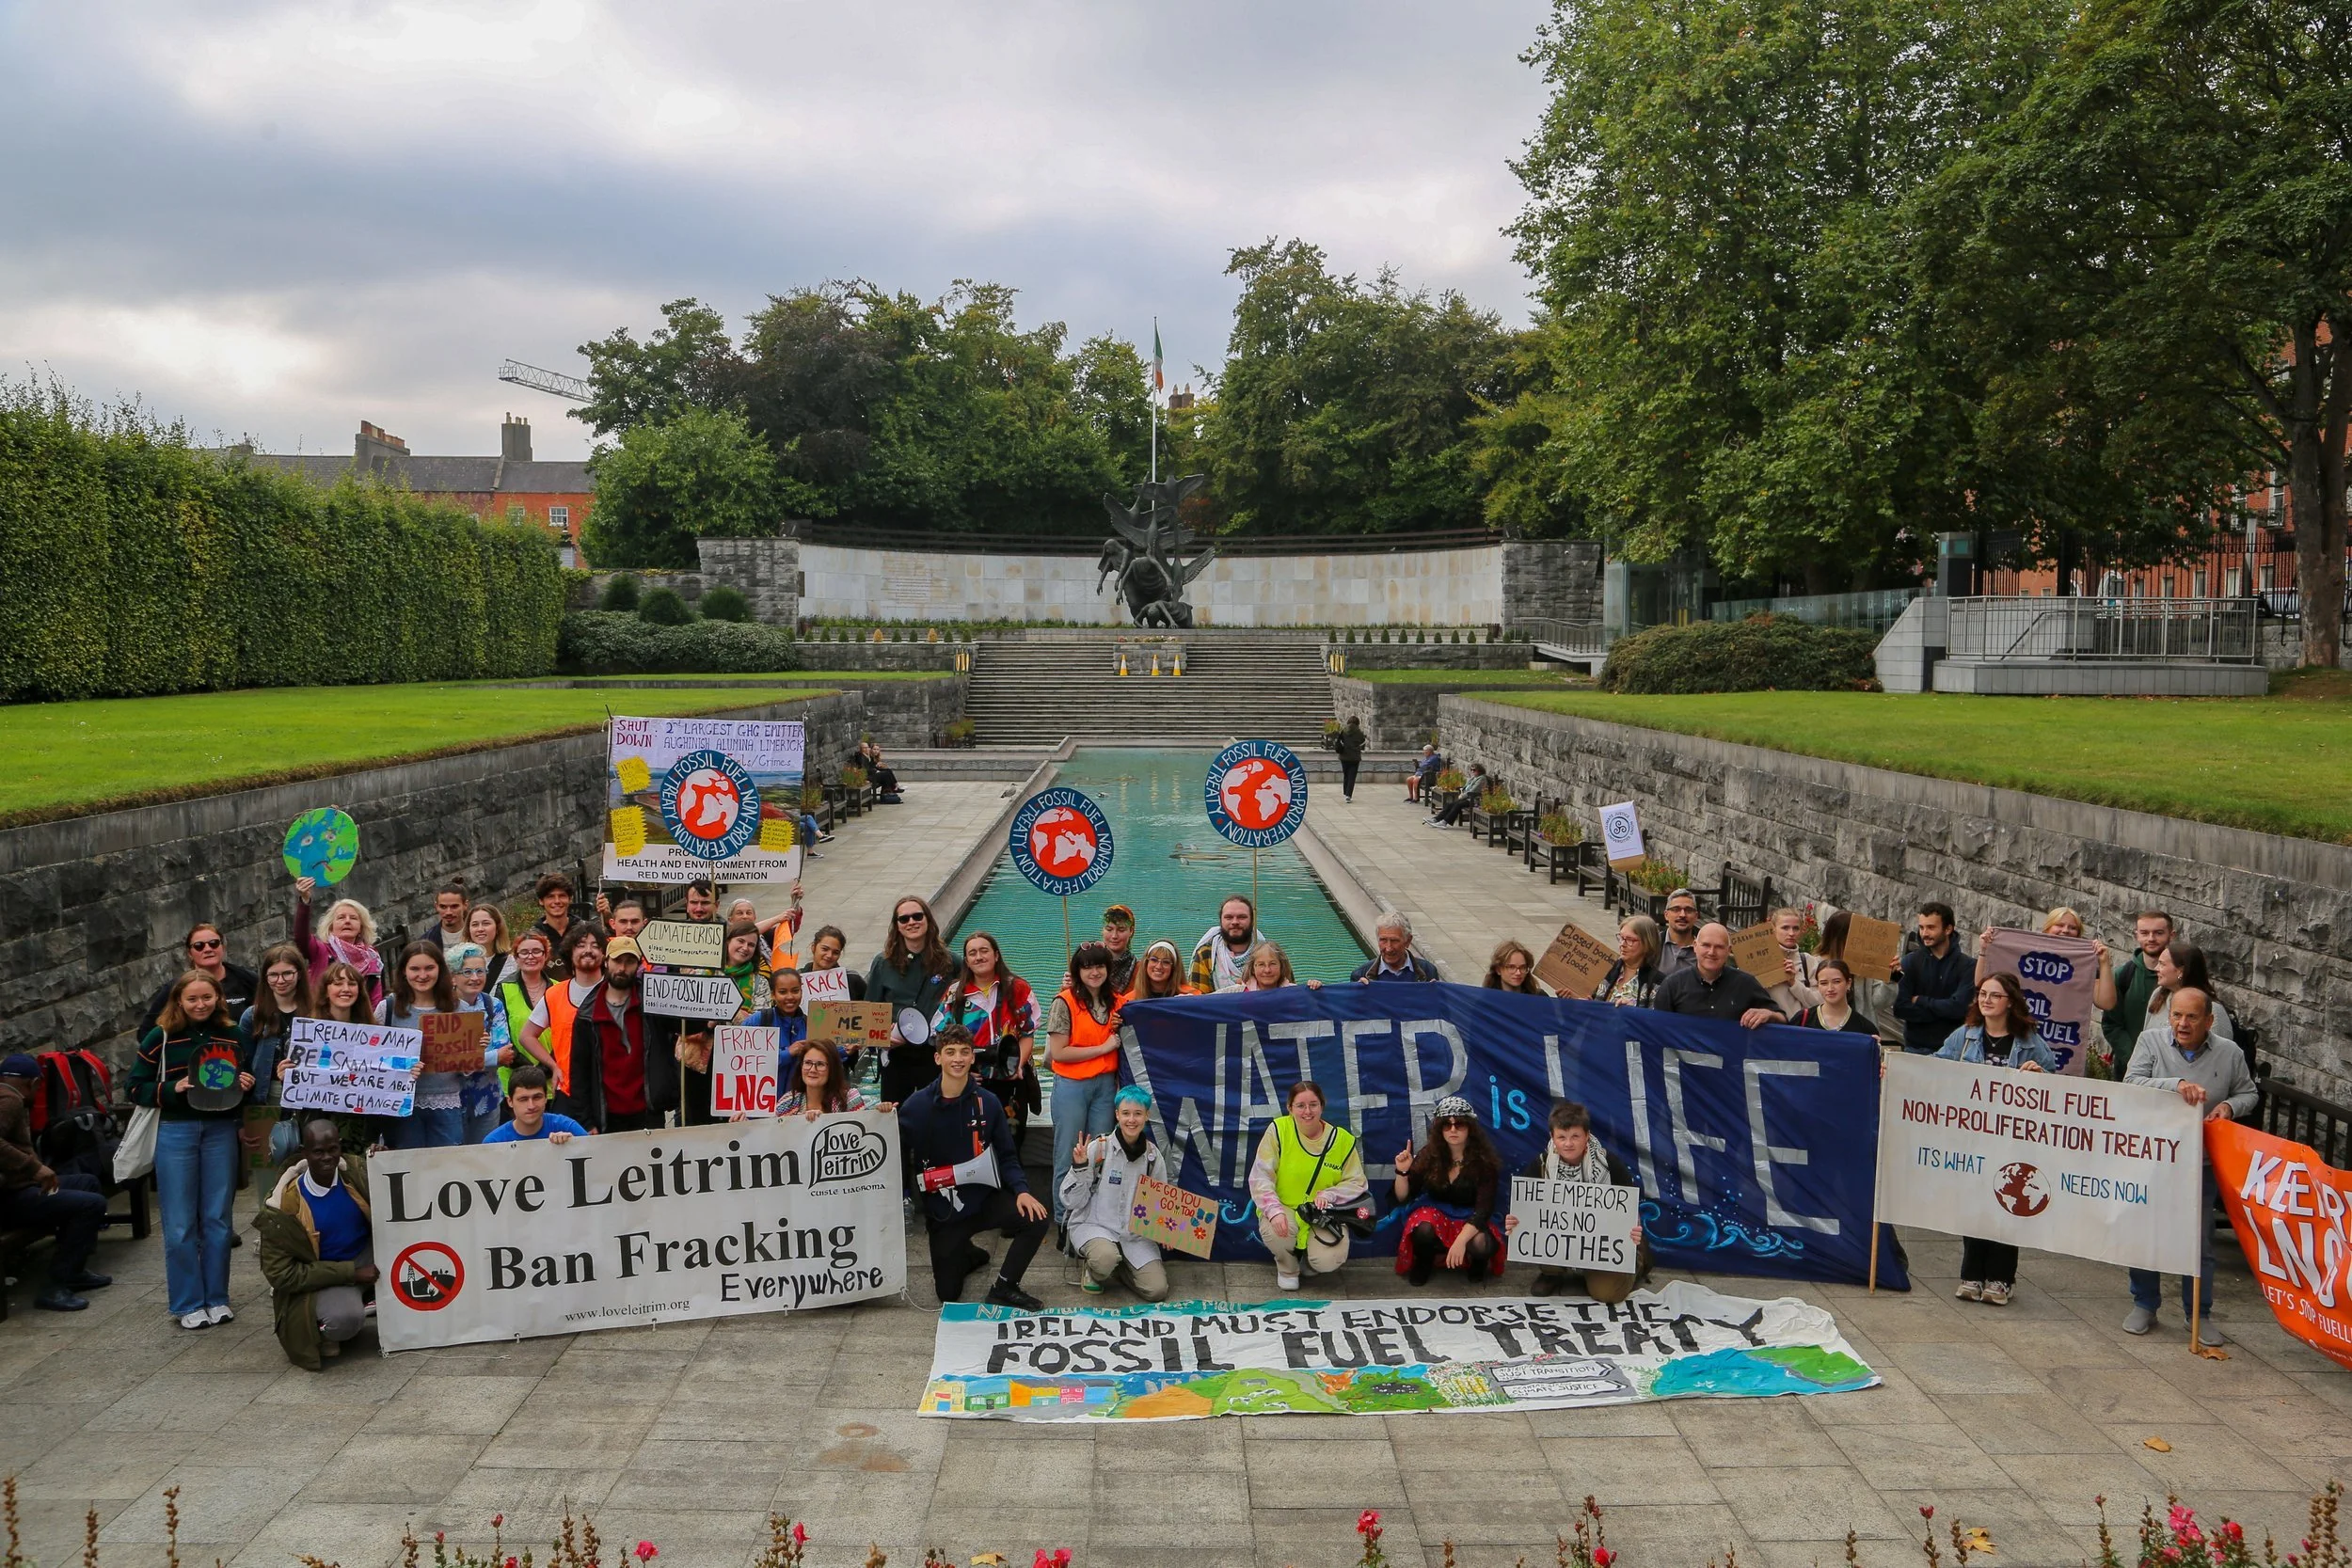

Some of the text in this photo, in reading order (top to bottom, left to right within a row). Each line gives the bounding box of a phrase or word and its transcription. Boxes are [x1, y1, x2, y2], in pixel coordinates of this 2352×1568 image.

[615, 732, 652, 748] DOWN
[616, 720, 649, 733] SHUT
[684, 722, 732, 736] LARGEST
[737, 723, 760, 736] GHG
[764, 724, 804, 739] EMITTER
[663, 737, 710, 751] AUGHINISH
[759, 739, 804, 752] LIMERICK
[675, 752, 719, 780] FOSSIL
[721, 756, 749, 790] FUEL
[661, 775, 681, 824] TREATY
[1038, 791, 1076, 810] FOSSIL
[1205, 742, 1306, 847] FOSSIL FUEL NON-PROLIFERATION TREATY
[670, 788, 758, 858] NON-PROLIFERATION
[1011, 803, 1041, 848] TREATY
[1079, 798, 1104, 832] FUEL
[617, 859, 787, 869] HEALTH AND ENVIRONMENT FROM
[638, 871, 660, 880] RED
[661, 871, 685, 880] MUD
[648, 923, 722, 946] CLIMATE CRISIS
[1562, 925, 1594, 950] Closed
[2024, 956, 2070, 979] STOP
[646, 977, 733, 1005] END FOSSIL FUEL
[802, 972, 847, 994] RACK
[294, 1019, 416, 1053] IRELAND MAY
[423, 1014, 462, 1034] END
[838, 1016, 863, 1030] ME
[869, 1029, 888, 1040] DIE
[2037, 1021, 2074, 1044] FUEL
[721, 1027, 776, 1054] FRACK
[291, 1045, 387, 1073] BE SMALL
[730, 1054, 768, 1072] OFF
[291, 1070, 416, 1092] BUT WE CARE ABOUT
[715, 1073, 777, 1113] LNG
[344, 1093, 403, 1111] CHANGE
[1120, 1019, 1468, 1188] WATER
[1490, 1074, 1531, 1131] is
[1970, 1079, 2116, 1121] A FOSSIL FUEL
[1902, 1099, 2181, 1164] NON-PROLIFERATION TREATY
[816, 1148, 881, 1182] Leitrim
[1917, 1147, 2148, 1205] IT'S WHAT NEEDS NOW
[382, 1140, 803, 1222] Love Leitrim
[1140, 1175, 1149, 1184] IF
[1151, 1180, 1163, 1192] WE
[1181, 1190, 1201, 1208] YOU
[1160, 1197, 1174, 1210] GO
[1513, 1180, 1629, 1213] THE EMPEROR
[1539, 1209, 1596, 1233] HAS NO
[485, 1218, 858, 1291] Ban Fracking
[1518, 1231, 1624, 1265] CLOTHES
[721, 1267, 884, 1308] Everywhere
[564, 1299, 691, 1322] www.loveleitrim.org
[996, 1300, 1672, 1340] IRELAND MUST ENDORSE THE
[2262, 1282, 2352, 1343] LET'S STOP FUELL
[986, 1307, 1767, 1373] FOSSIL FUEL TREATY
[1499, 1370, 1527, 1378] JUST
[1531, 1366, 1596, 1376] TRANSITION
